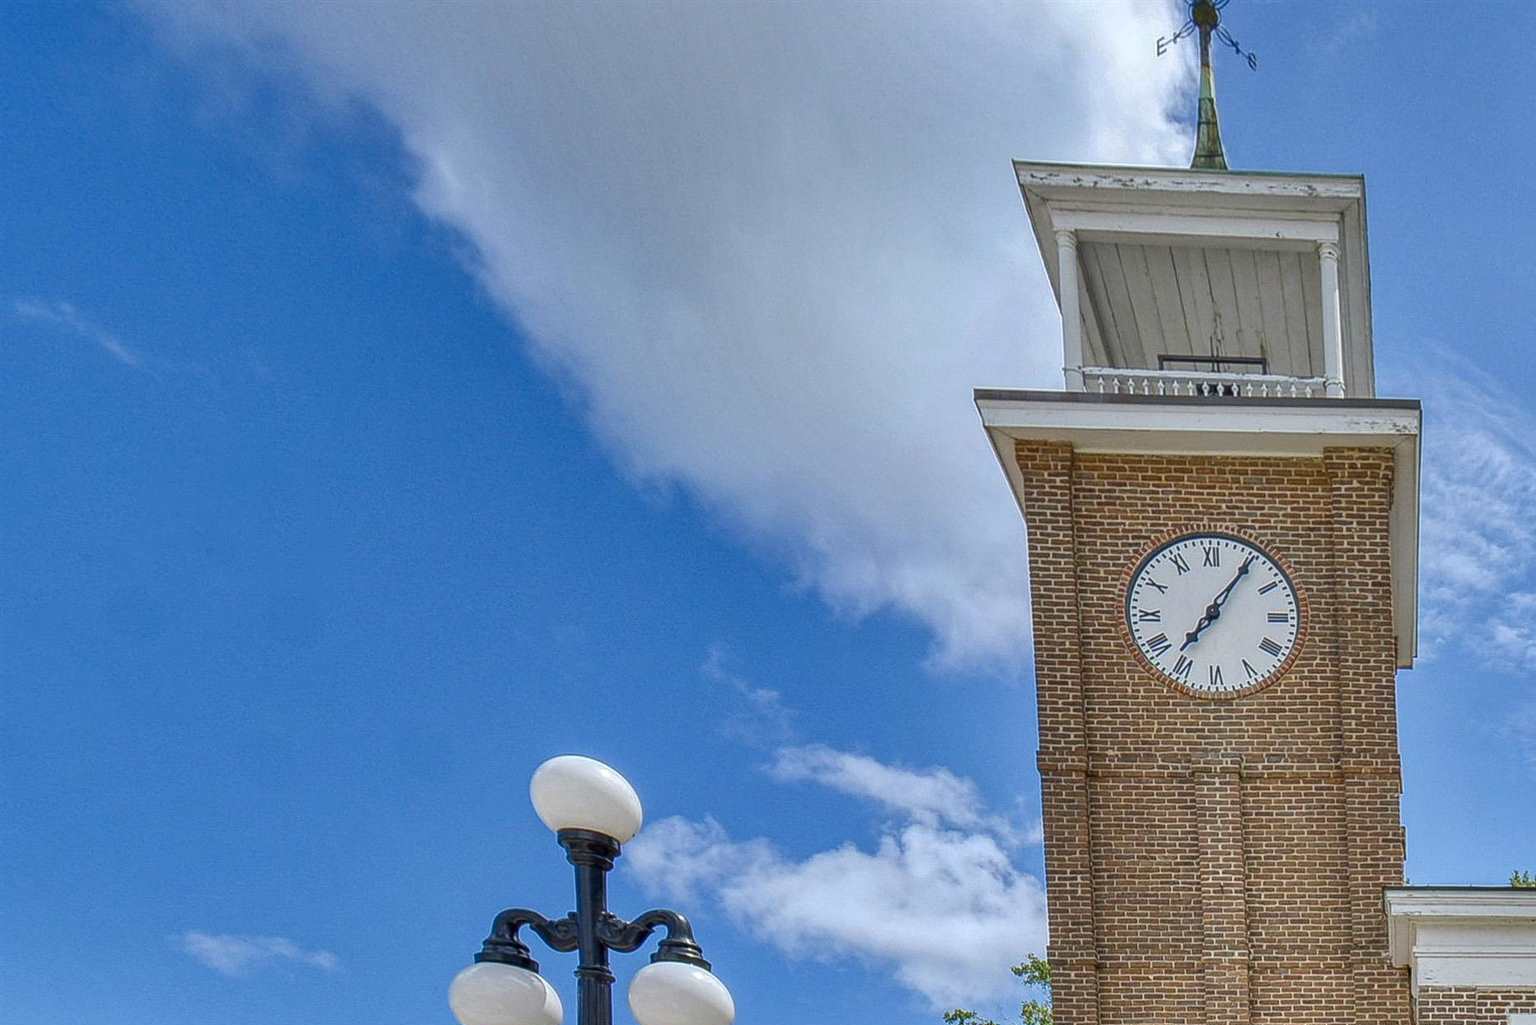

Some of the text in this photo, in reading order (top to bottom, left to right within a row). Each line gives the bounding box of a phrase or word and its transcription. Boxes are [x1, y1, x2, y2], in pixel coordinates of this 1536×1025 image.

[1169, 553, 1190, 575] XI
[1203, 547, 1220, 567] XII
[1145, 578, 1168, 594] X
[1139, 609, 1161, 622] IX
[1146, 633, 1172, 657] VIII
[1172, 654, 1193, 679] VII
[1209, 665, 1224, 685] VI
[1242, 659, 1258, 679] V
